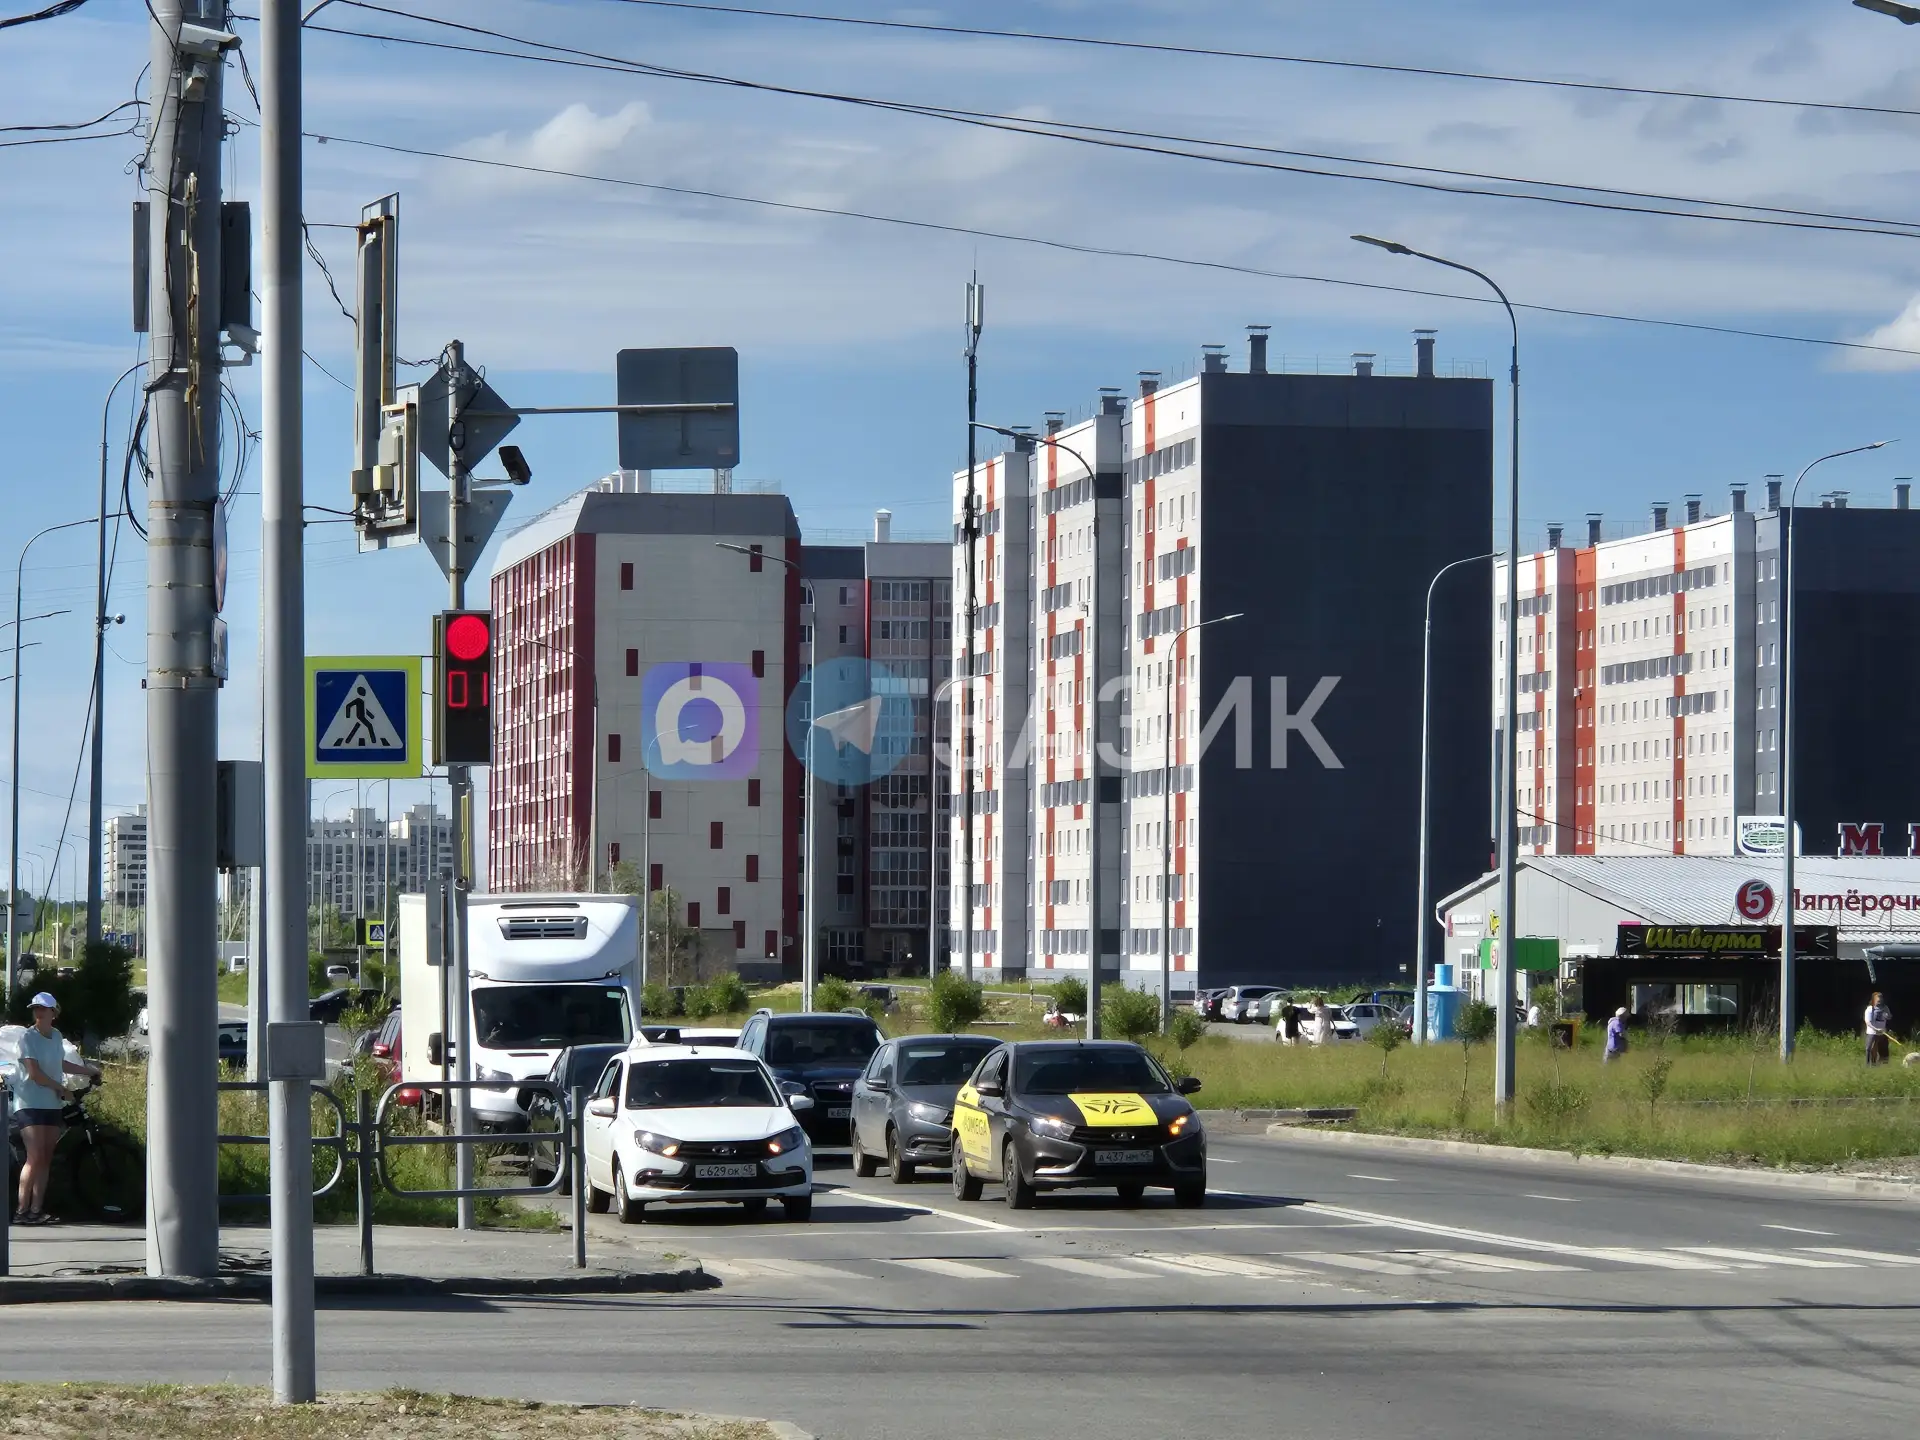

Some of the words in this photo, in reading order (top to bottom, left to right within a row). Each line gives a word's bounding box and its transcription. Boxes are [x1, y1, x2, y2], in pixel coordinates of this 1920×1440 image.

[448, 671, 489, 707] 01
[1742, 822, 1769, 834] МЕТРО
[1745, 883, 1766, 914] 5
[1646, 927, 1762, 951] Шаверма
